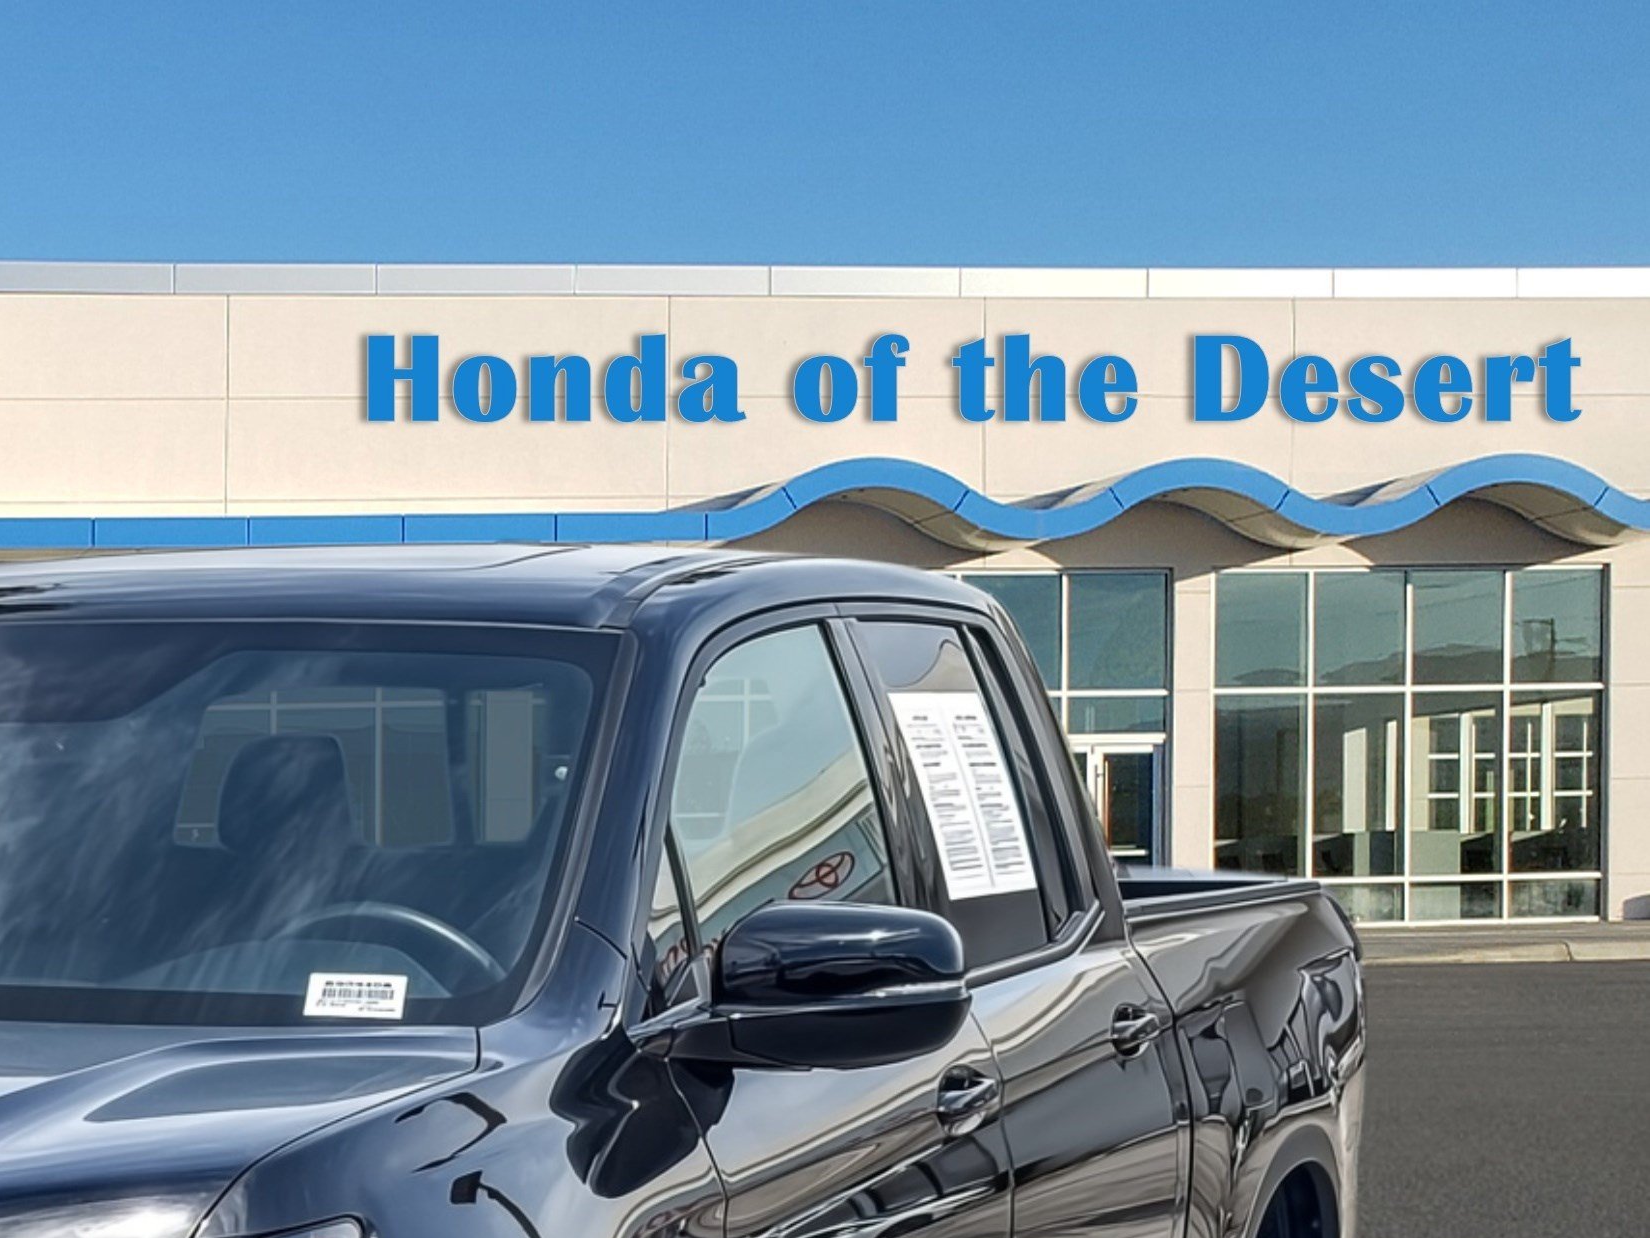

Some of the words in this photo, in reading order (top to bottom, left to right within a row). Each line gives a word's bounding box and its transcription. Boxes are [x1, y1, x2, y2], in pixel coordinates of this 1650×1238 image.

[366, 334, 747, 423] Honda
[793, 333, 911, 423] of
[951, 333, 1138, 423] the
[1192, 334, 1583, 423] Desert
